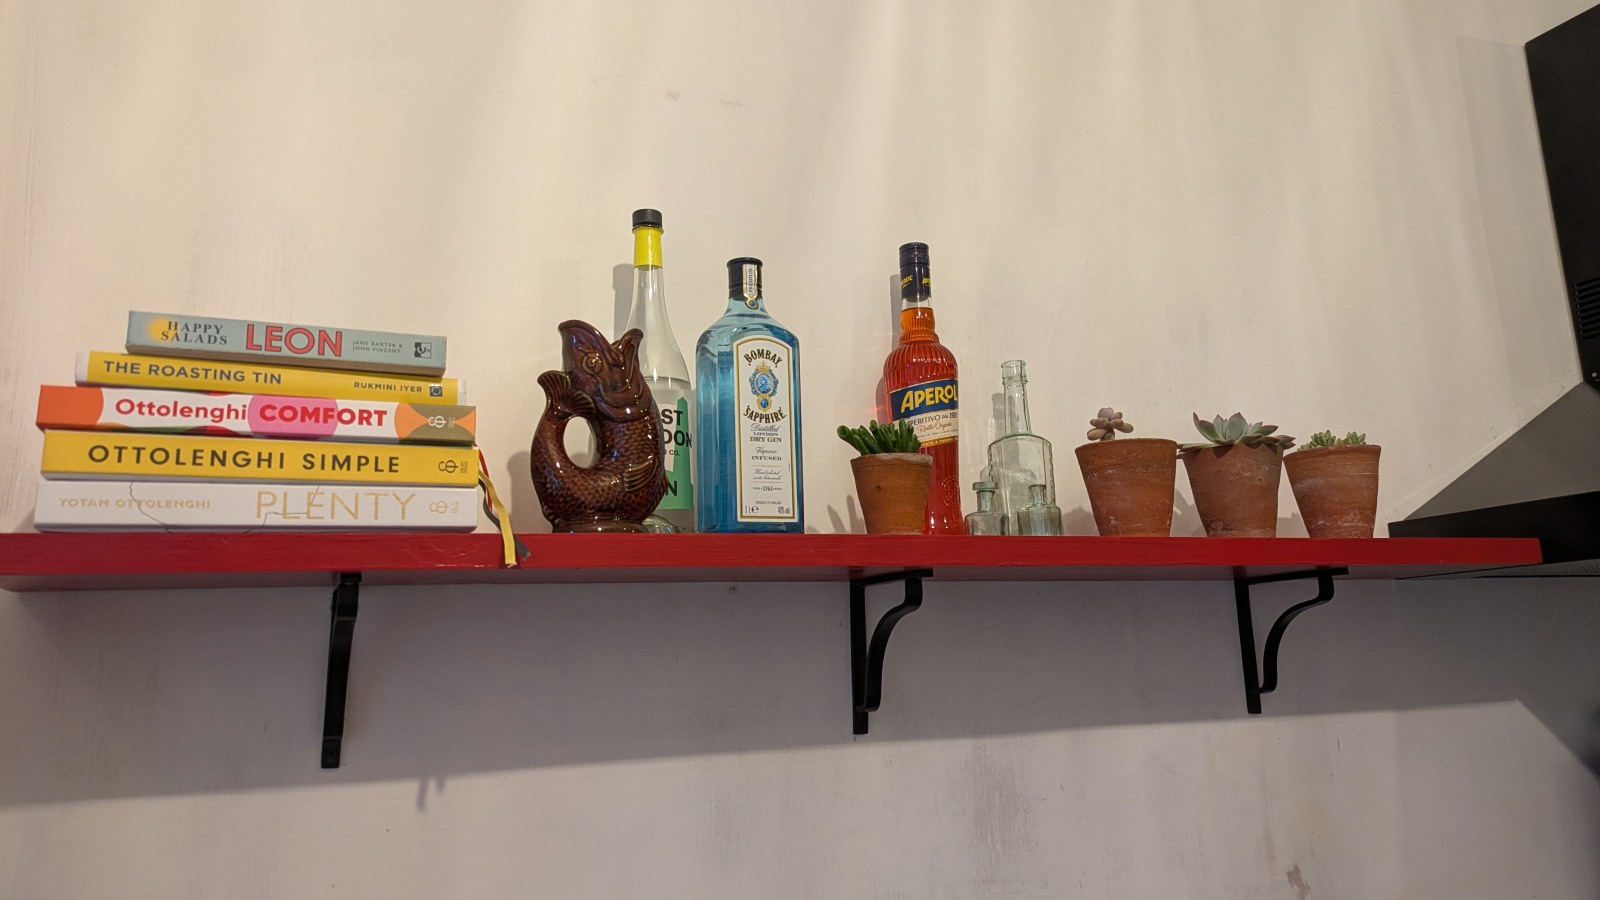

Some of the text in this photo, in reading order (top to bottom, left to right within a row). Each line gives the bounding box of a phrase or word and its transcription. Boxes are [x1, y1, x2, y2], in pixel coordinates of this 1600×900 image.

[168, 321, 223, 335] HAPPY
[160, 331, 228, 346] SALADS
[246, 324, 343, 357] LEON
[743, 348, 783, 368] BOMBAY
[103, 360, 282, 385] THE ROASTING TIN
[353, 381, 397, 391] RUKMINI
[900, 384, 958, 414] APEROL
[115, 398, 388, 427] Ottolenghi COMFORT
[743, 405, 787, 424] SAPPHIRE
[906, 414, 941, 426] APERITIVO
[750, 423, 781, 432] Distilled
[662, 428, 693, 449] DON
[88, 445, 400, 473] OTTOLENGHI SIMPLE
[59, 498, 211, 509] YOTAM OTTOLENGHI
[256, 491, 417, 521] PLENTY
